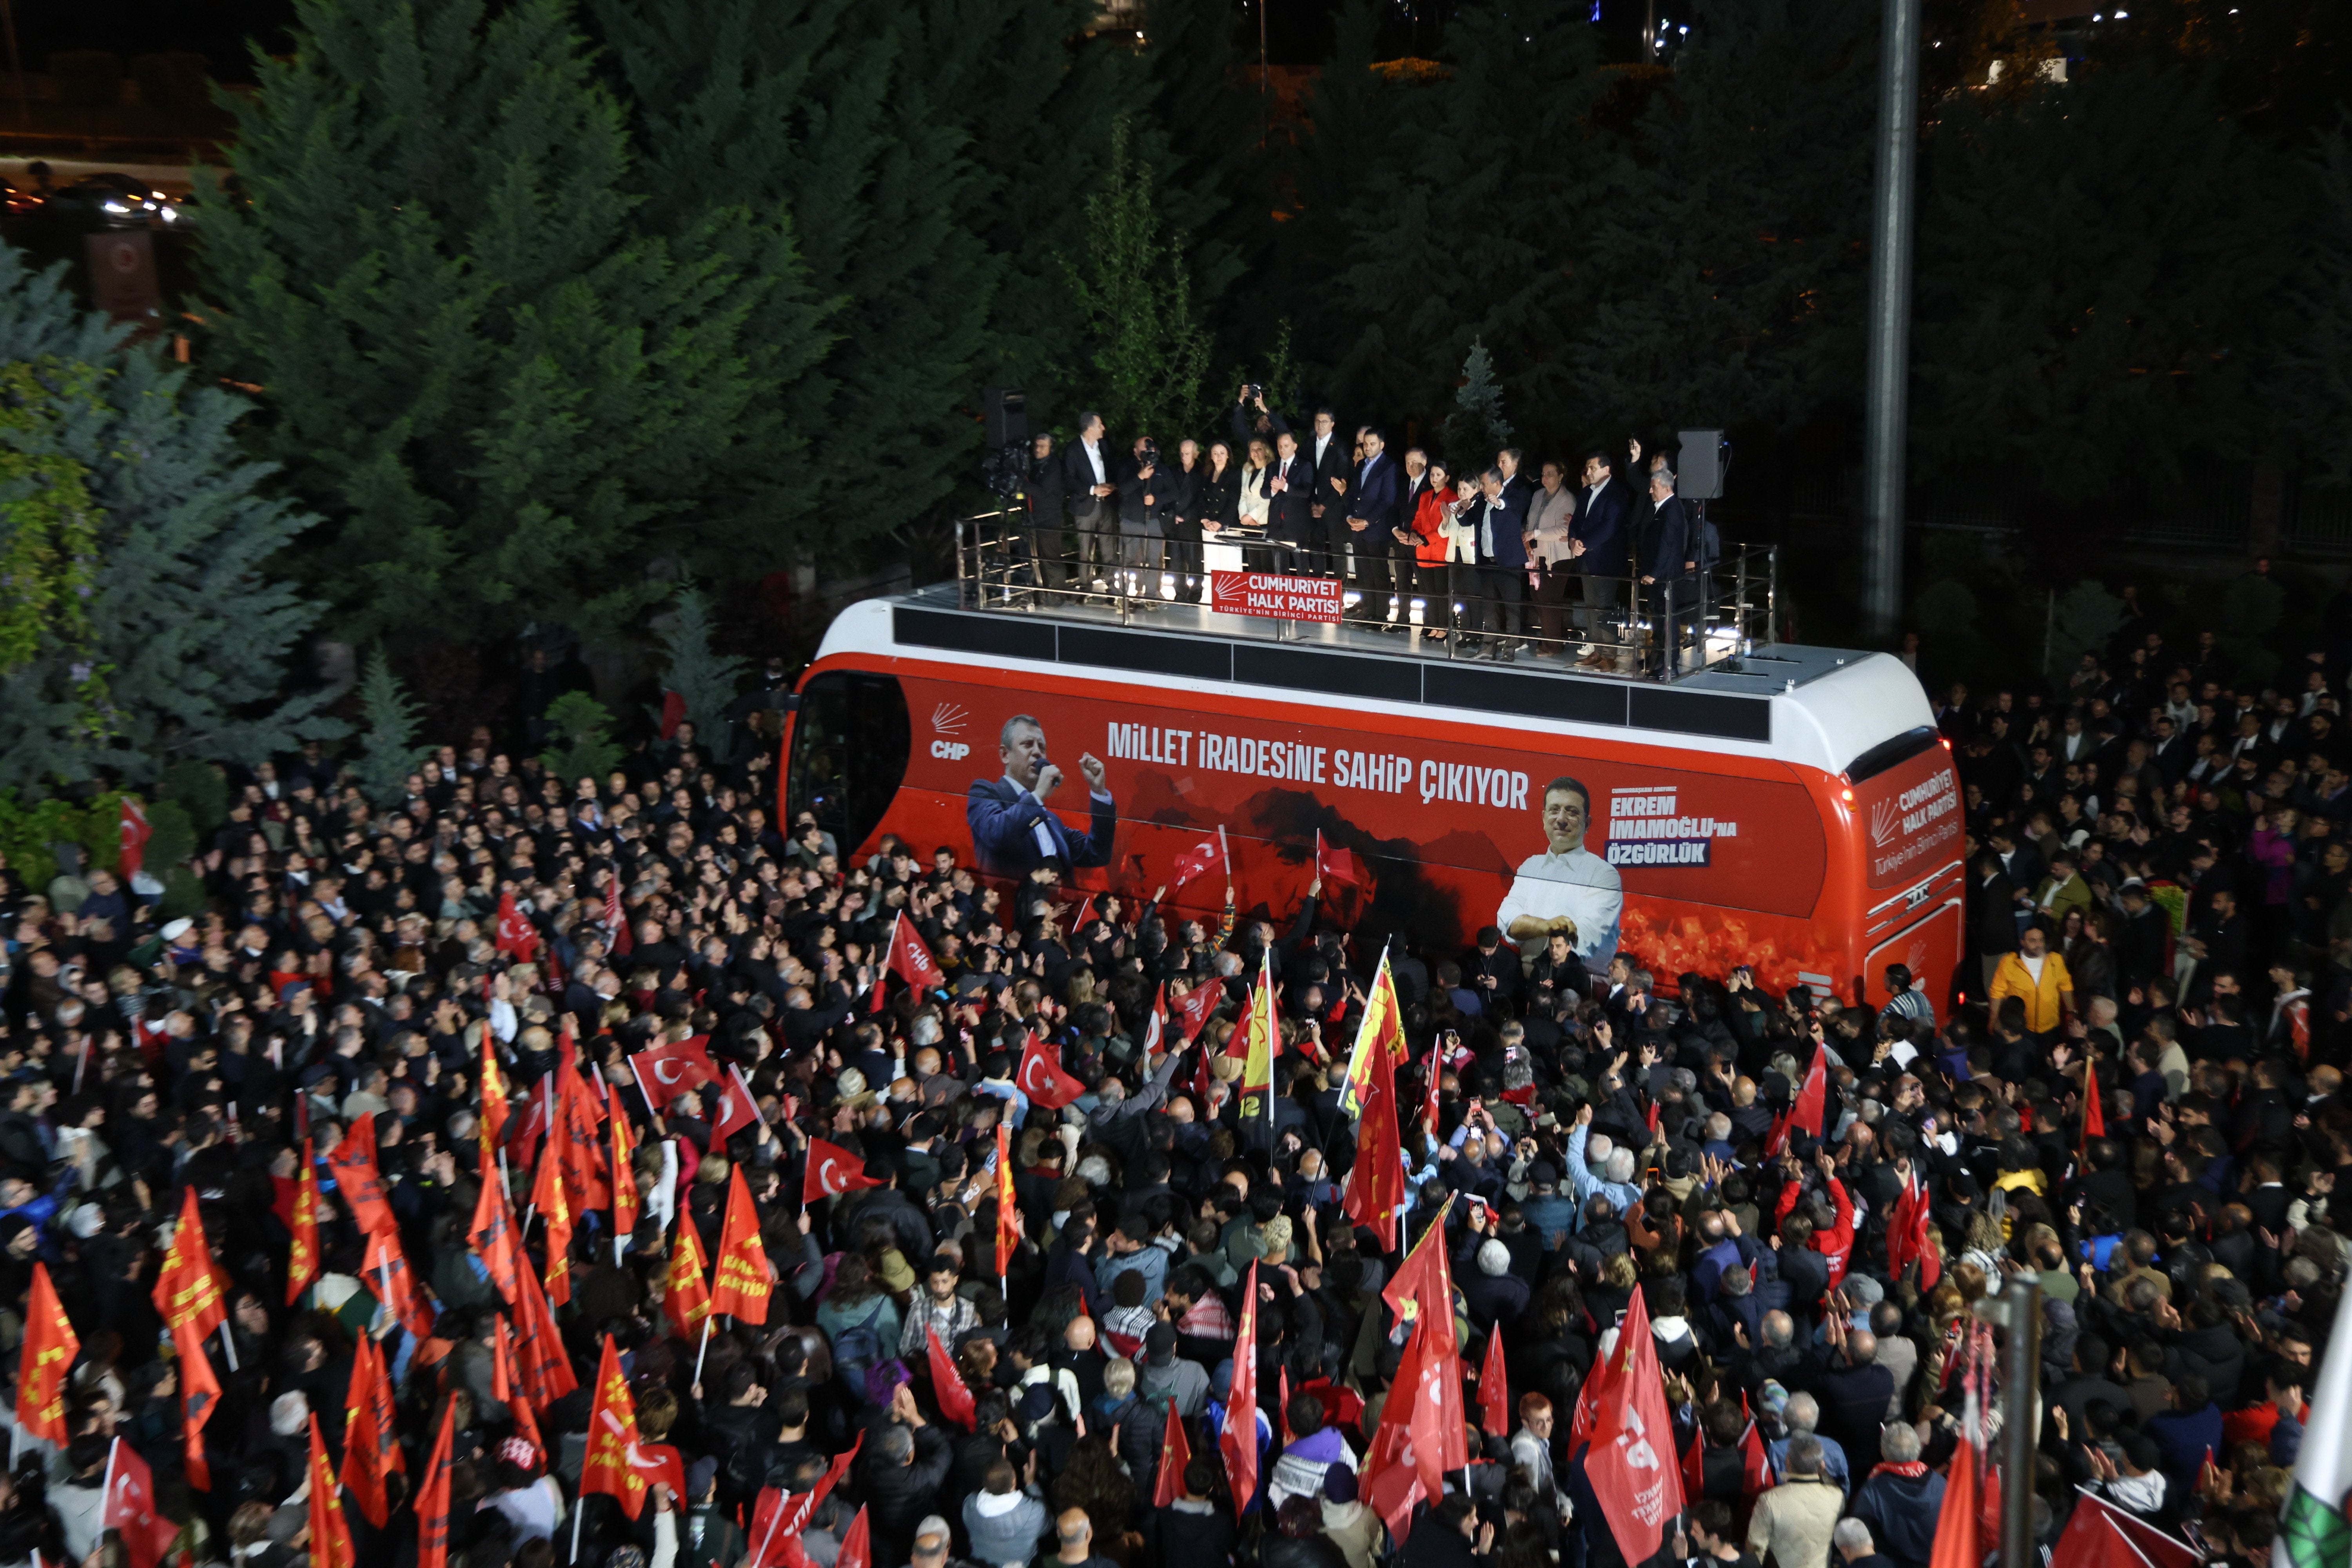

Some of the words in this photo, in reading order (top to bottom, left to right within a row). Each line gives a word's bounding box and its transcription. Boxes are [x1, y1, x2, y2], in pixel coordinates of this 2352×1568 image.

[1249, 575, 1337, 596] CUMHURİYET
[1219, 605, 1270, 615] TÜRKİYE'NİN
[1273, 610, 1304, 619] BİRİNCİ
[1307, 613, 1339, 622] PARTİSİ
[1248, 592, 1285, 610] HALK
[1289, 597, 1339, 615] PARTİSİ
[931, 740, 970, 760] CHP
[1419, 760, 1528, 810] ÇIKIYOR
[1899, 768, 1953, 811] CUMHURİYET
[1610, 795, 1676, 817] EKREM
[1902, 808, 1927, 835] HALK
[1927, 785, 1957, 822] PARTİSİ
[1608, 842, 1706, 865] ÖZGÜRLÜK
